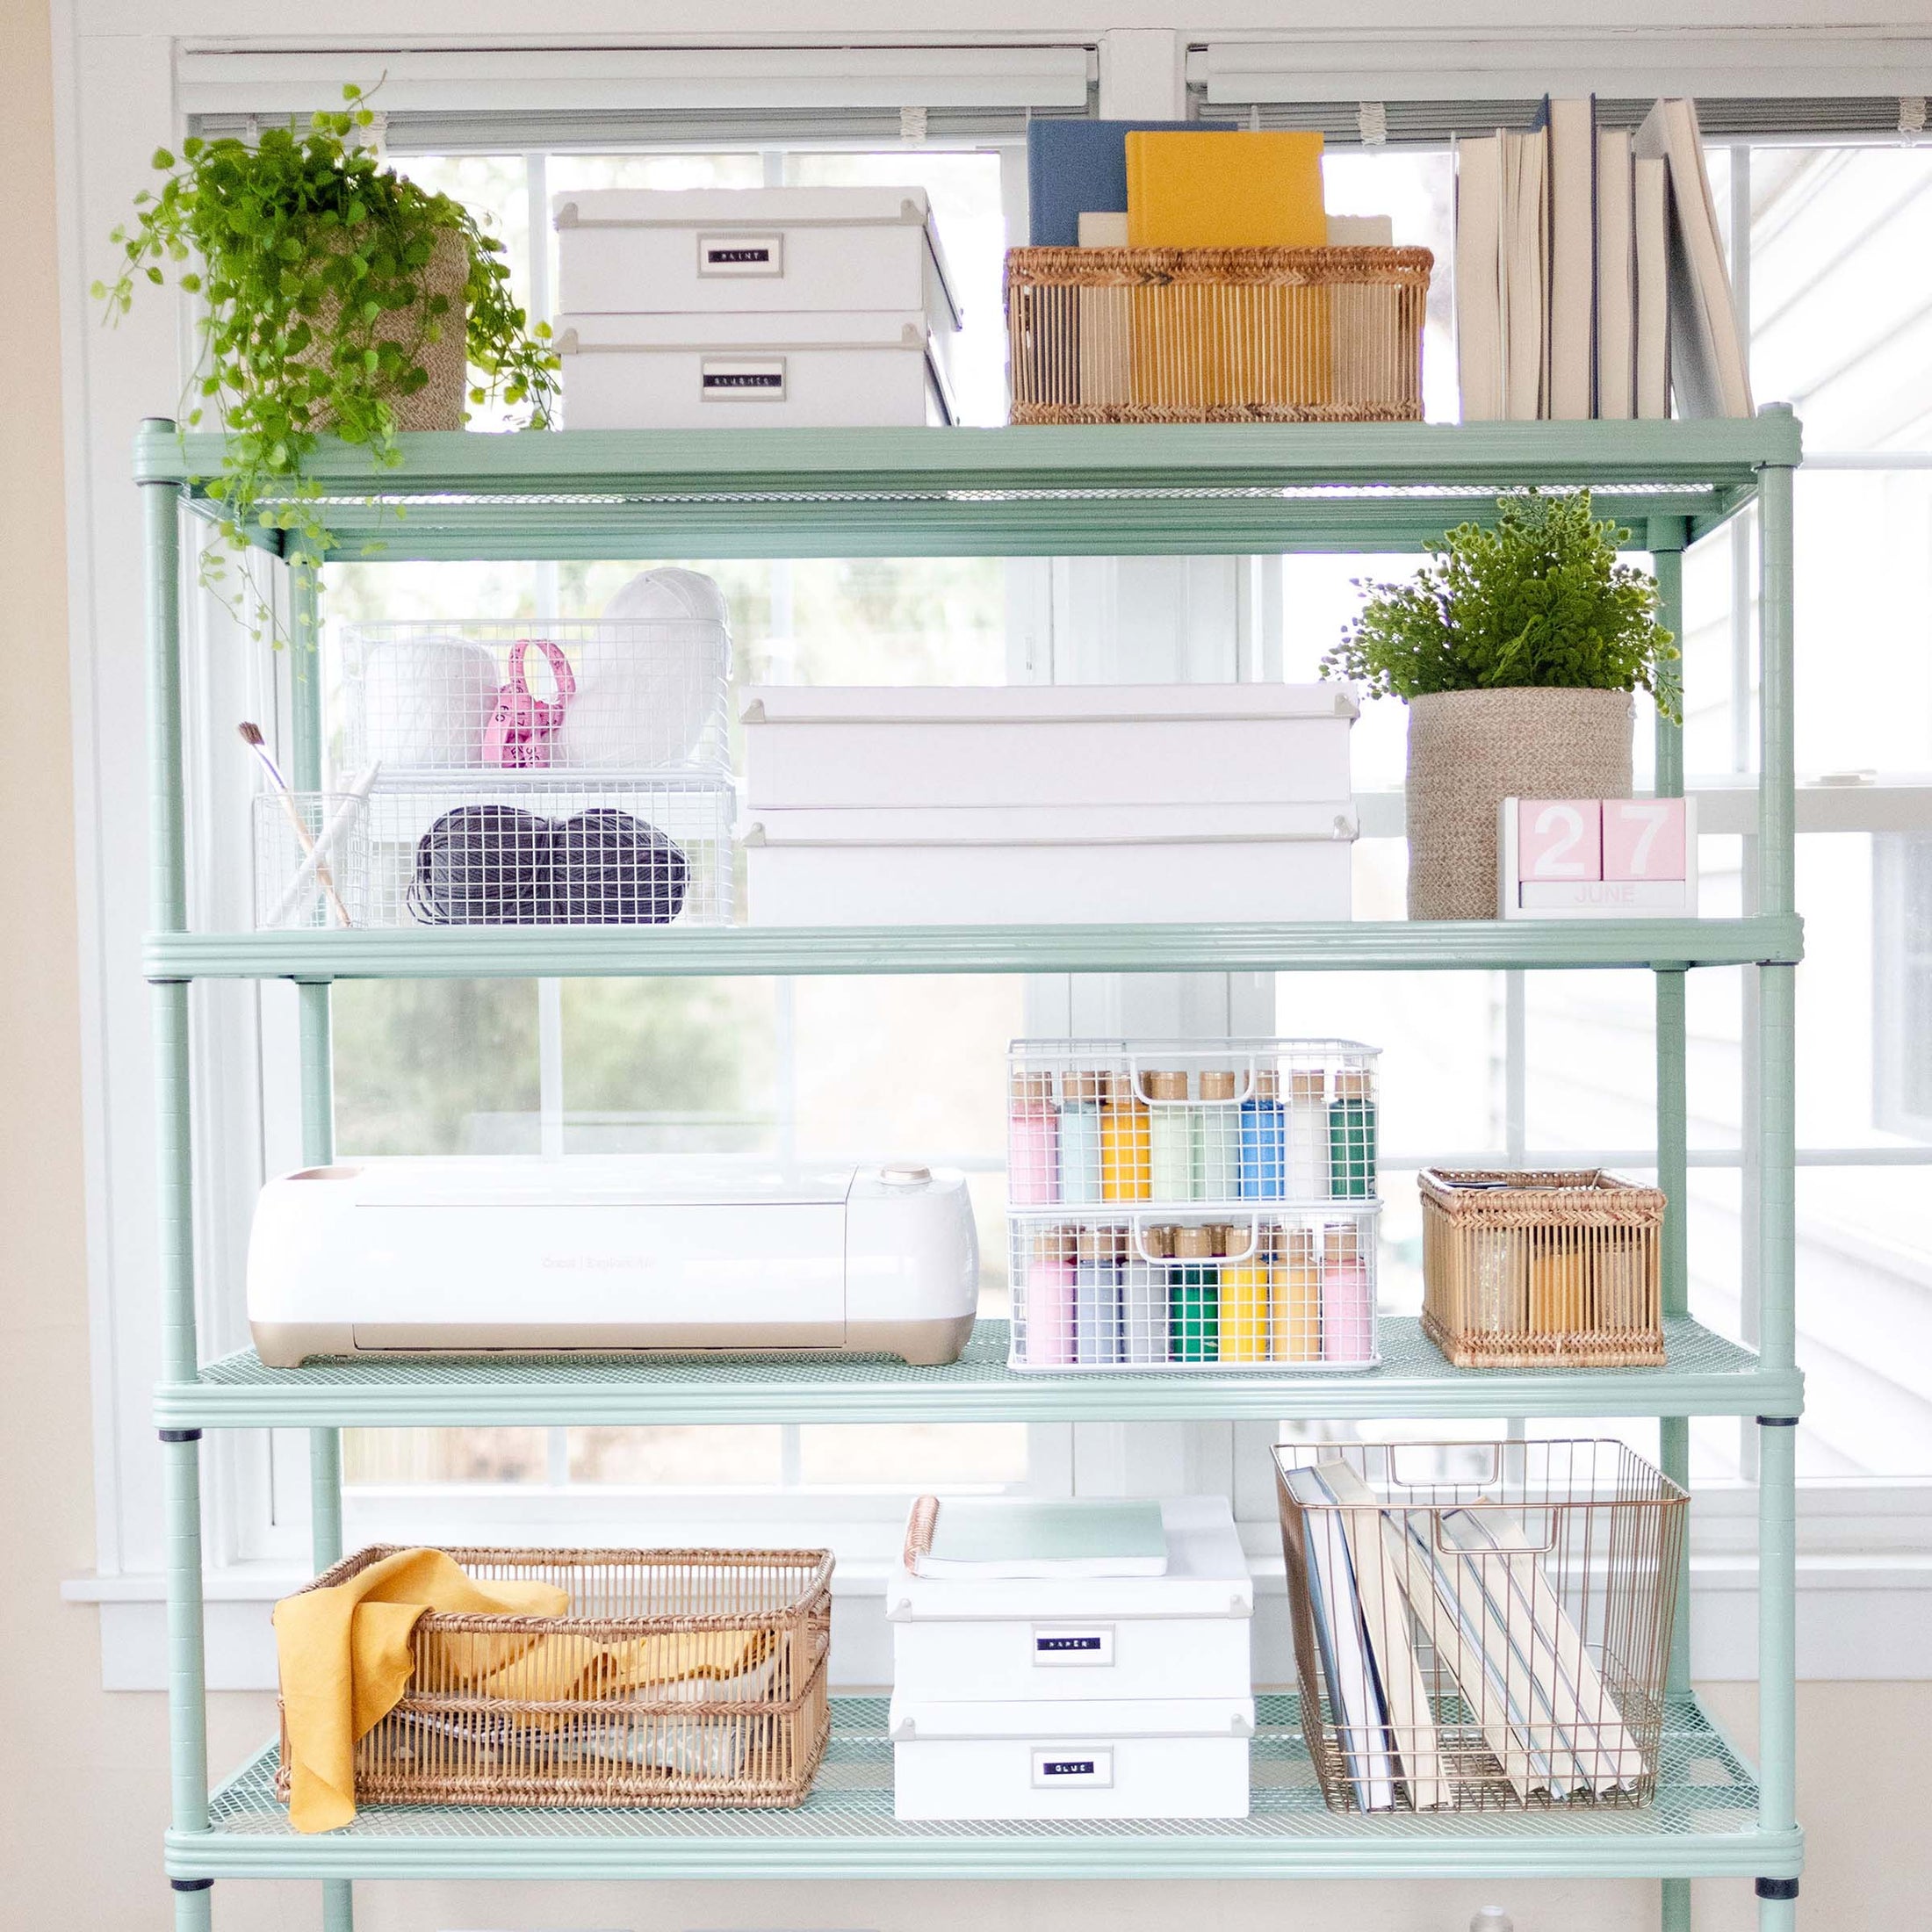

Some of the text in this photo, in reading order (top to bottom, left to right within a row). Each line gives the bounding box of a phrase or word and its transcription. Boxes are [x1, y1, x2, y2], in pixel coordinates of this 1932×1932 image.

[517, 711, 525, 726] 17
[1574, 884, 1634, 903] JUNE
[1055, 1763, 1085, 1772] GLUE
